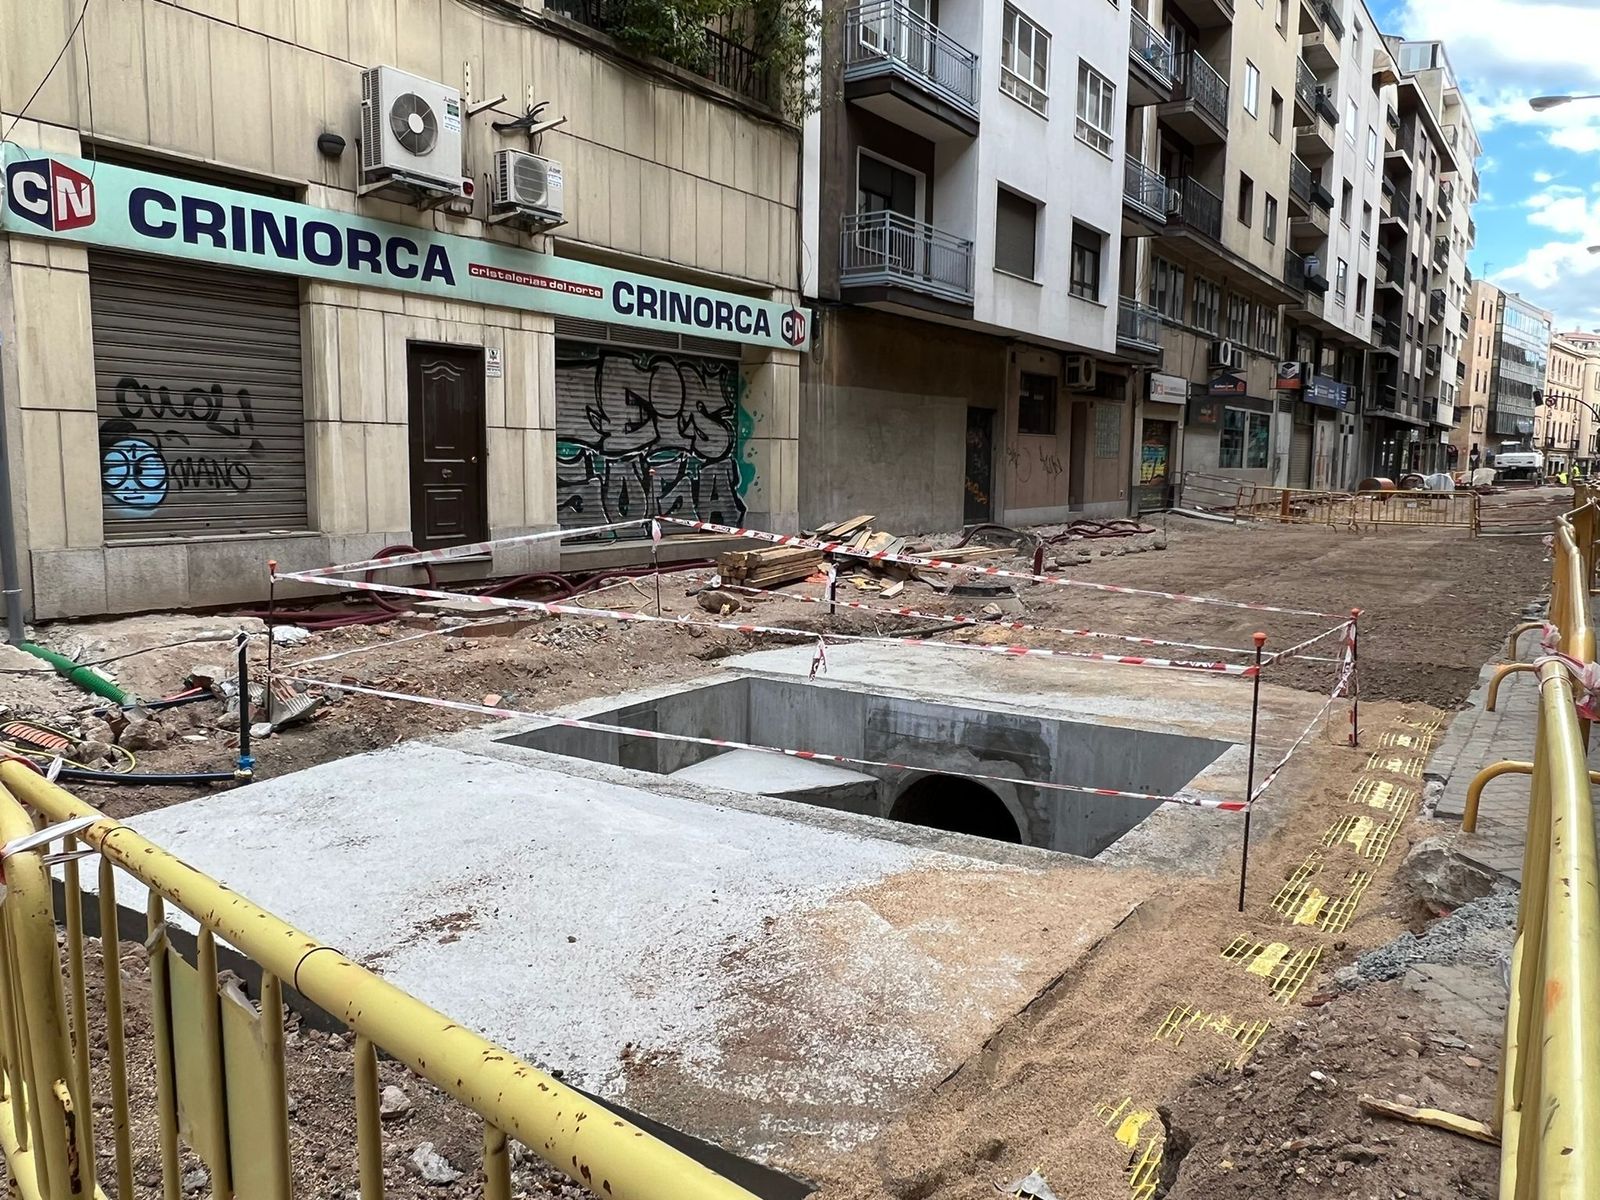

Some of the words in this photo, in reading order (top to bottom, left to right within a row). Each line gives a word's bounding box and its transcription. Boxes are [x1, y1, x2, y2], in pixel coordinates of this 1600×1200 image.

[12, 171, 91, 221] CN
[128, 187, 456, 286] CRINORCA
[471, 267, 547, 287] cristalerias
[549, 280, 567, 292] del
[568, 285, 601, 297] norte
[612, 280, 771, 338] CRINORCA
[782, 316, 806, 340] CN
